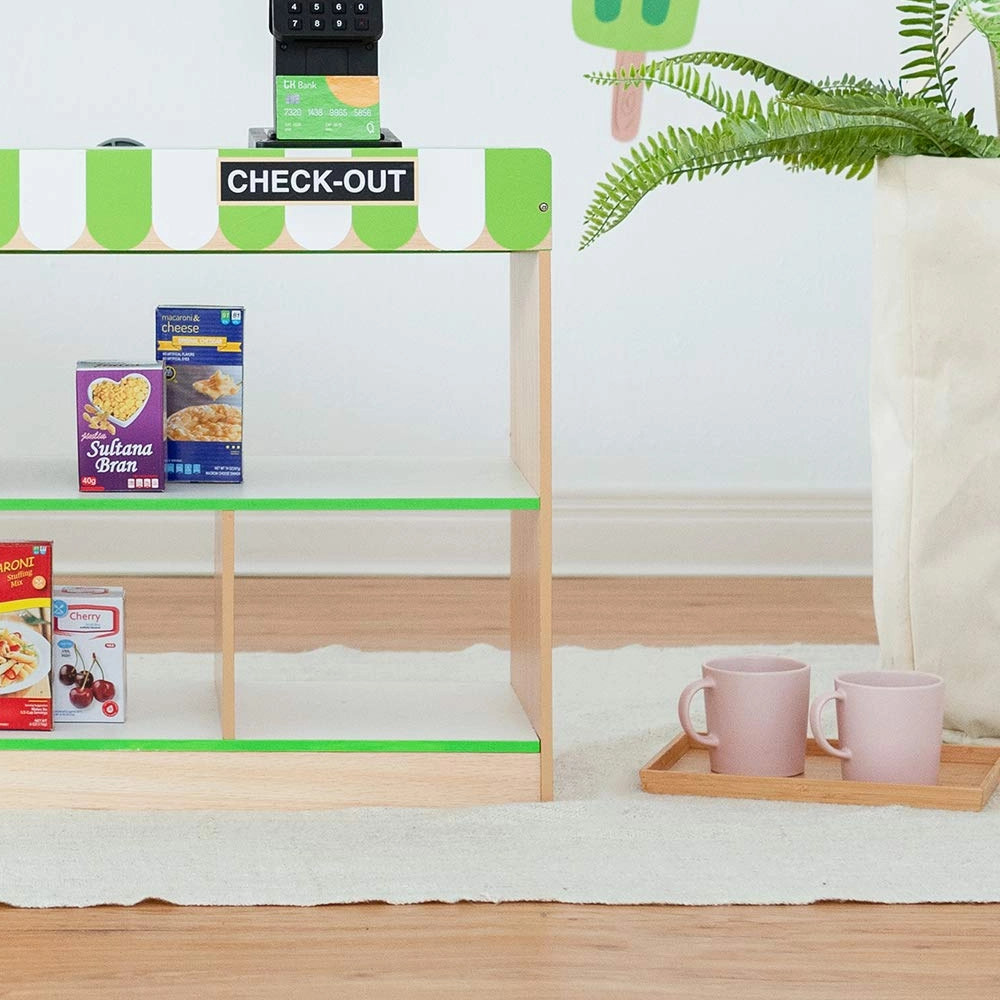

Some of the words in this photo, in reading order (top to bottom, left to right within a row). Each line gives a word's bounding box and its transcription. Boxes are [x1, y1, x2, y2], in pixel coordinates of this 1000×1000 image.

[291, 3, 297, 11] 4
[313, 3, 320, 11] 5
[335, 3, 342, 11] 6
[358, 3, 364, 11] 0
[297, 80, 317, 89] Bank
[227, 168, 406, 194] CHECK-OUT
[161, 321, 200, 333] cheese
[86, 438, 154, 458] Sultana
[95, 456, 138, 473] Bran
[81, 476, 97, 486] 40g
[7, 570, 33, 582] Stuffing
[10, 580, 23, 588] Mix
[69, 611, 101, 622] Cherry
